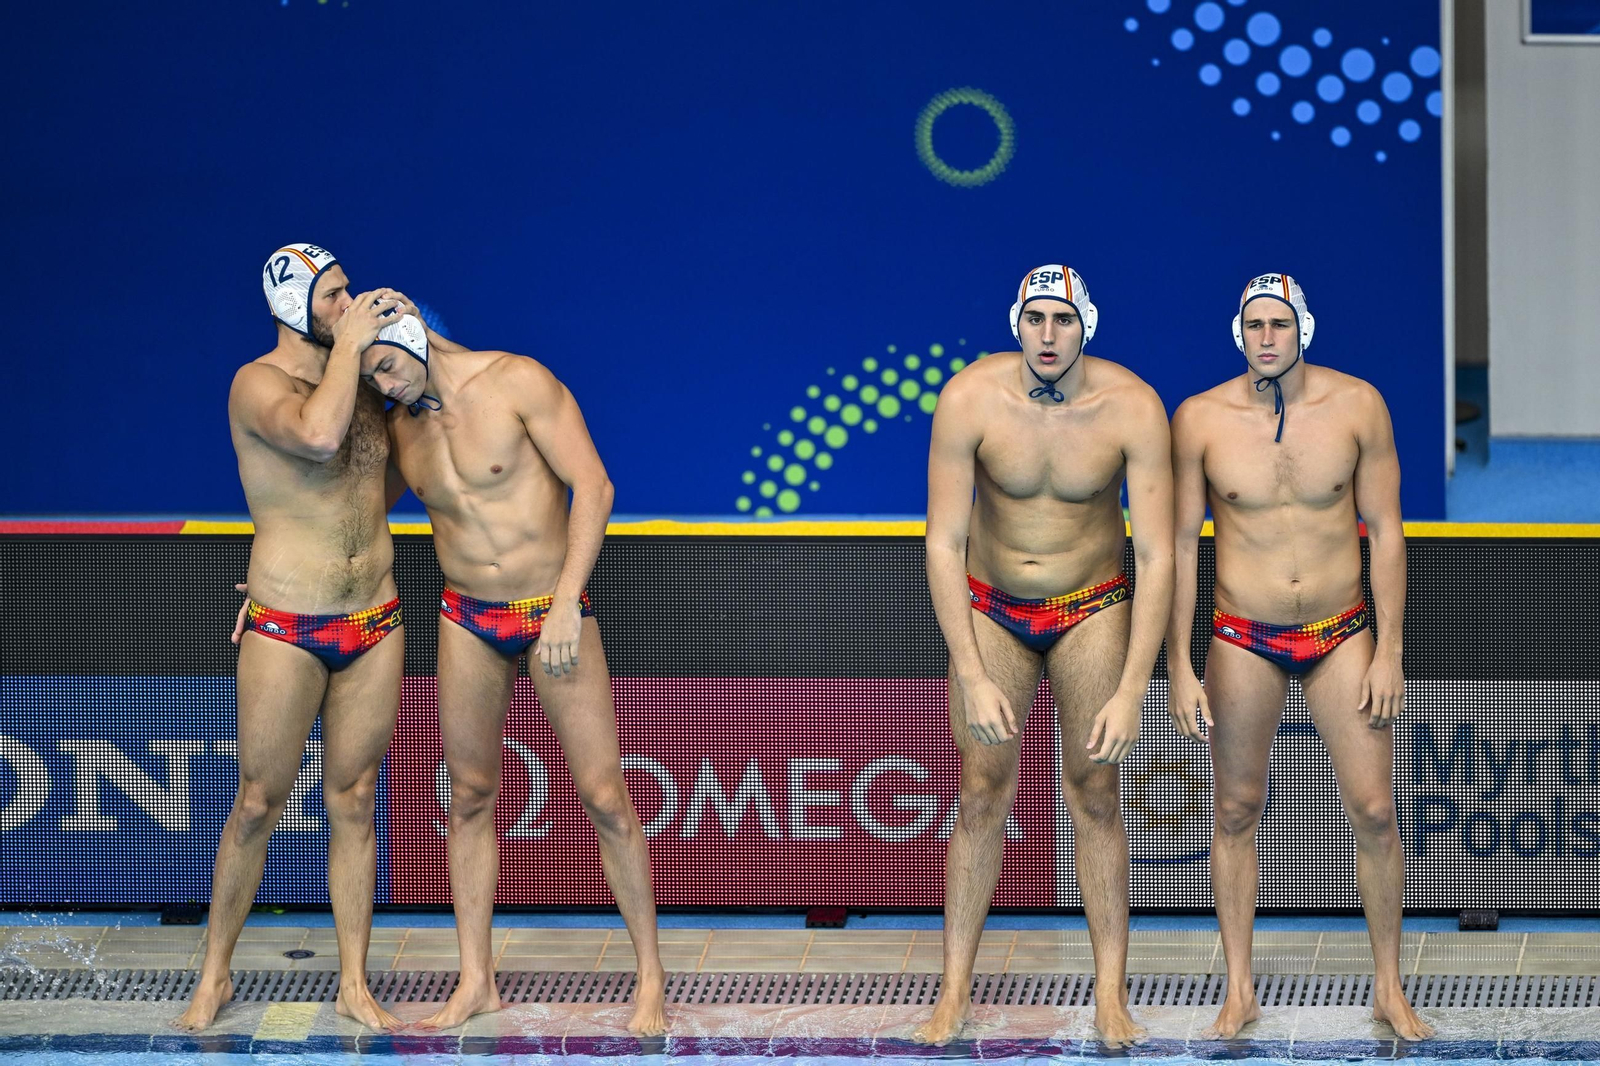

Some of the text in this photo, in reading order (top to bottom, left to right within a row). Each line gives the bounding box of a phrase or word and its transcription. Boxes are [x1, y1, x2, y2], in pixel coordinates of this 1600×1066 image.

[265, 255, 294, 287] 12
[1029, 271, 1064, 286] ESP
[1249, 276, 1282, 289] ESP
[259, 624, 287, 635] TURBO
[1412, 795, 1600, 860] Pools
